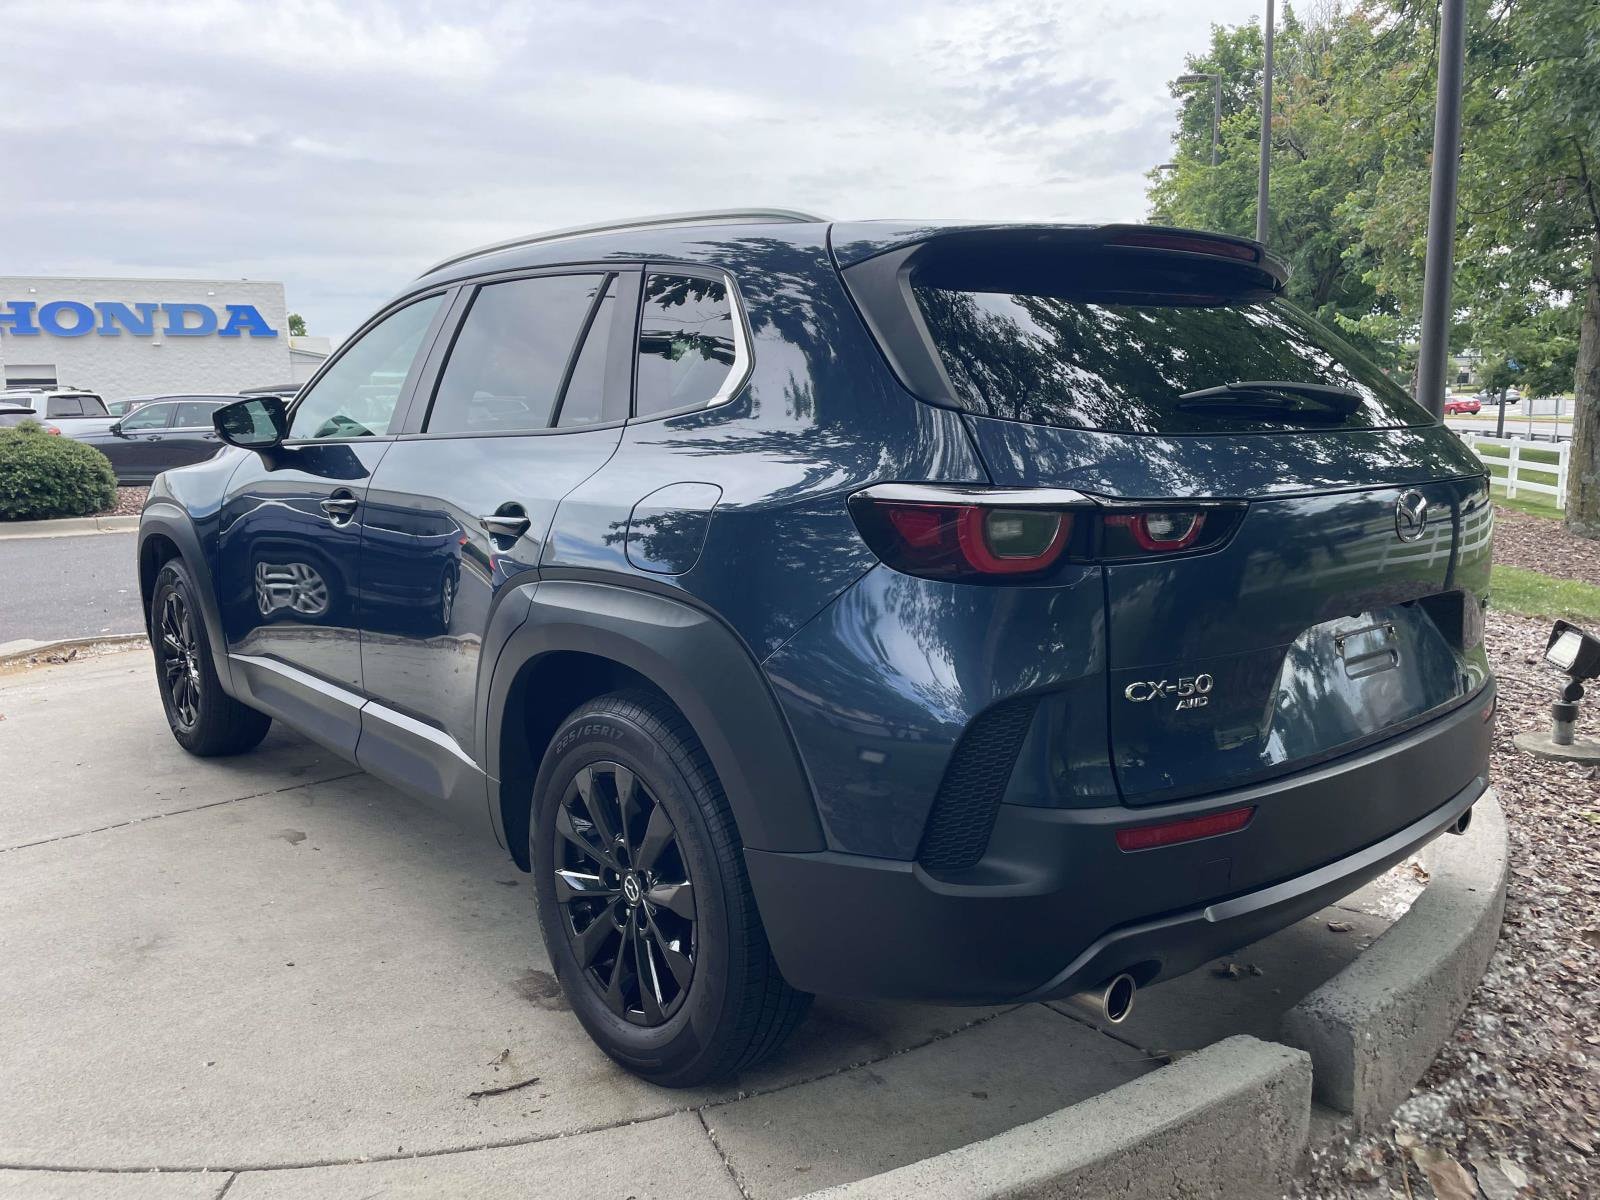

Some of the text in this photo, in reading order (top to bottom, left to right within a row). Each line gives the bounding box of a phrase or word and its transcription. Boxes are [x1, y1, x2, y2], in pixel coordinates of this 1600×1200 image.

[1124, 673, 1214, 702] CX-50
[1175, 696, 1209, 711] AWD
[555, 724, 625, 754] 225/65R17
